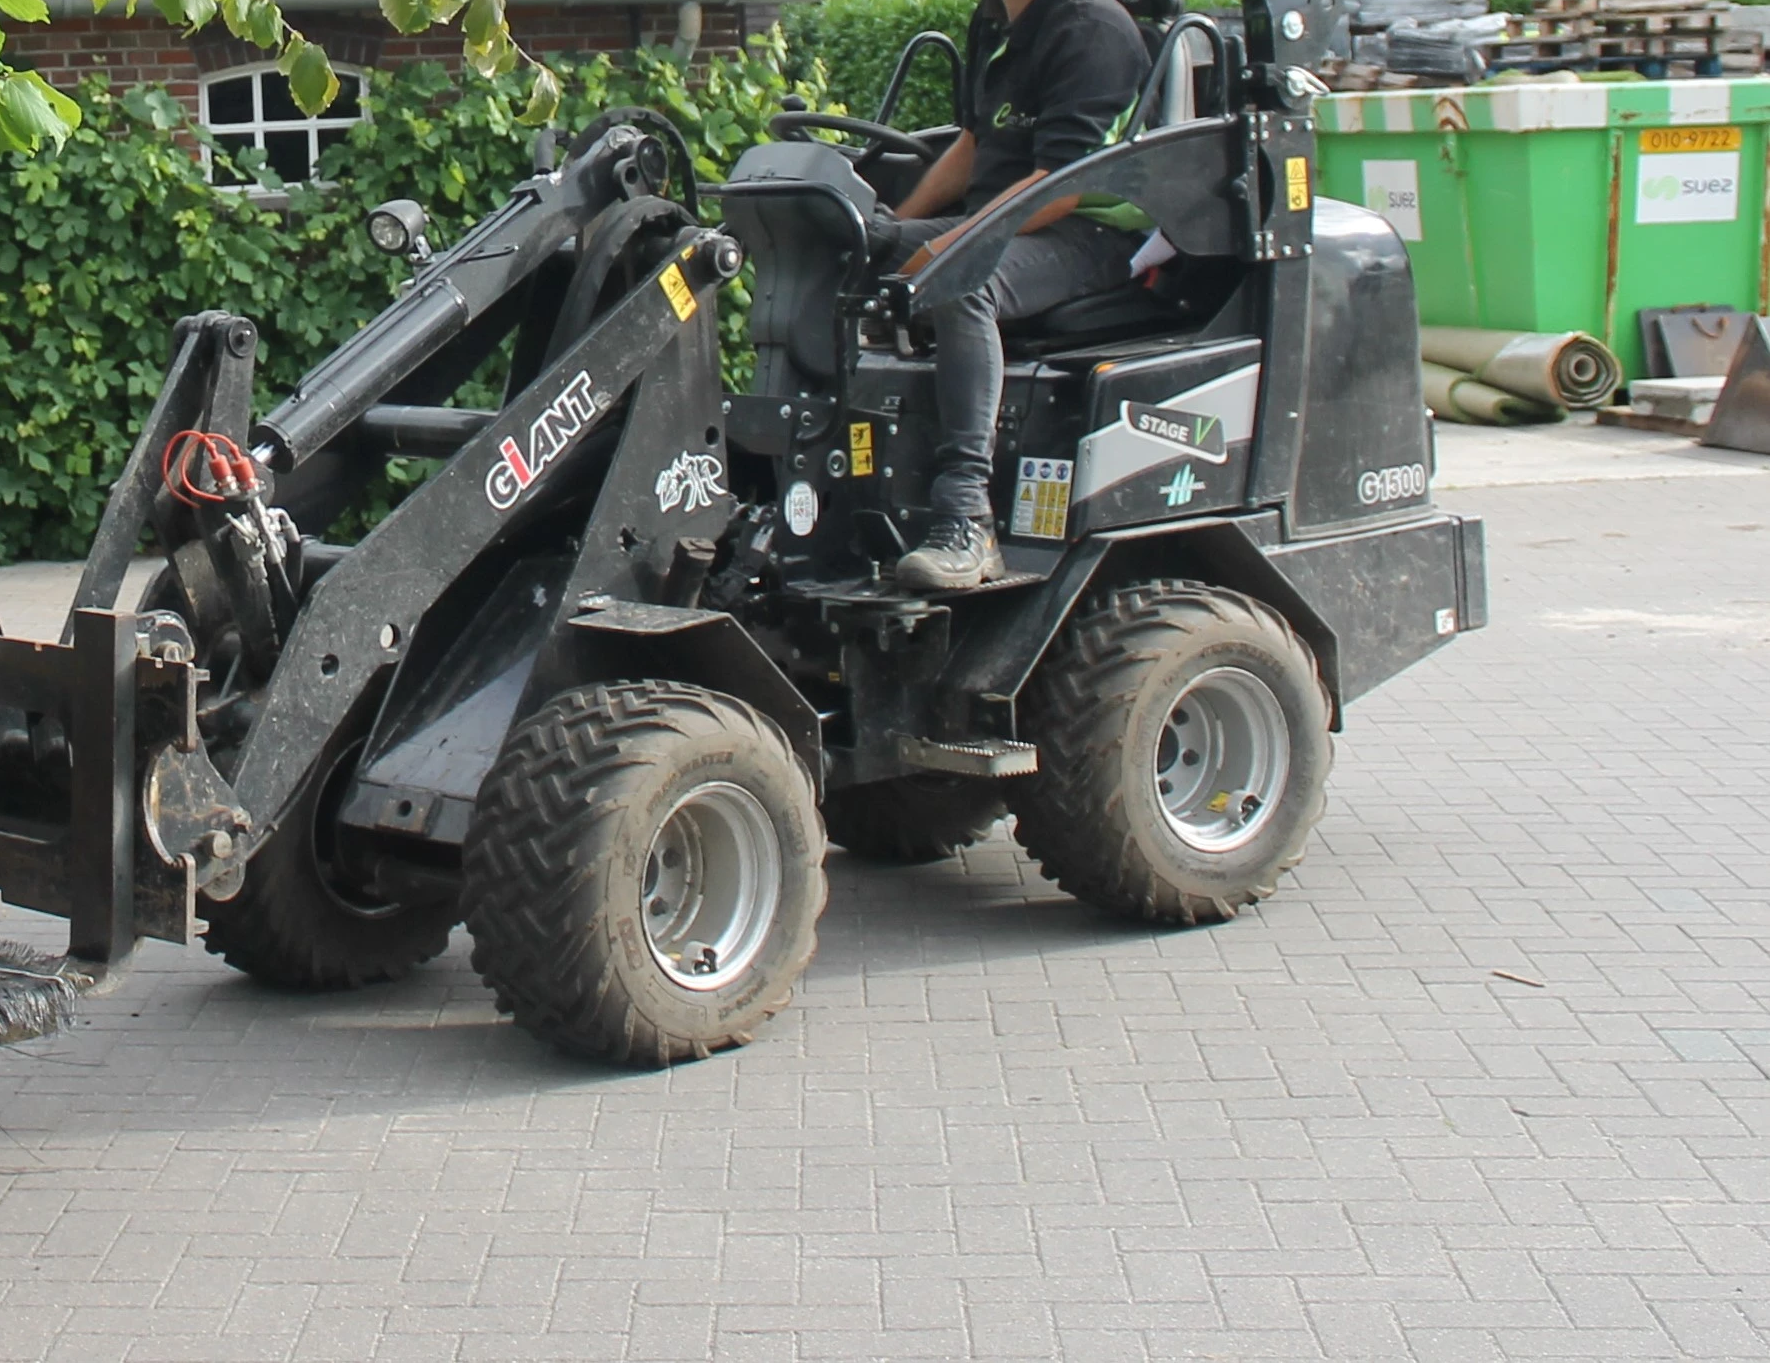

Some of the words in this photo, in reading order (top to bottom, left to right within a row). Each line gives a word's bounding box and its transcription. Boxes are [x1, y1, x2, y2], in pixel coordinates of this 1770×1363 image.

[1682, 178, 1733, 193] suez
[1389, 191, 1415, 208] suez
[1139, 413, 1190, 442] STAGE
[1194, 414, 1220, 446] V
[1357, 463, 1425, 504] G1500
